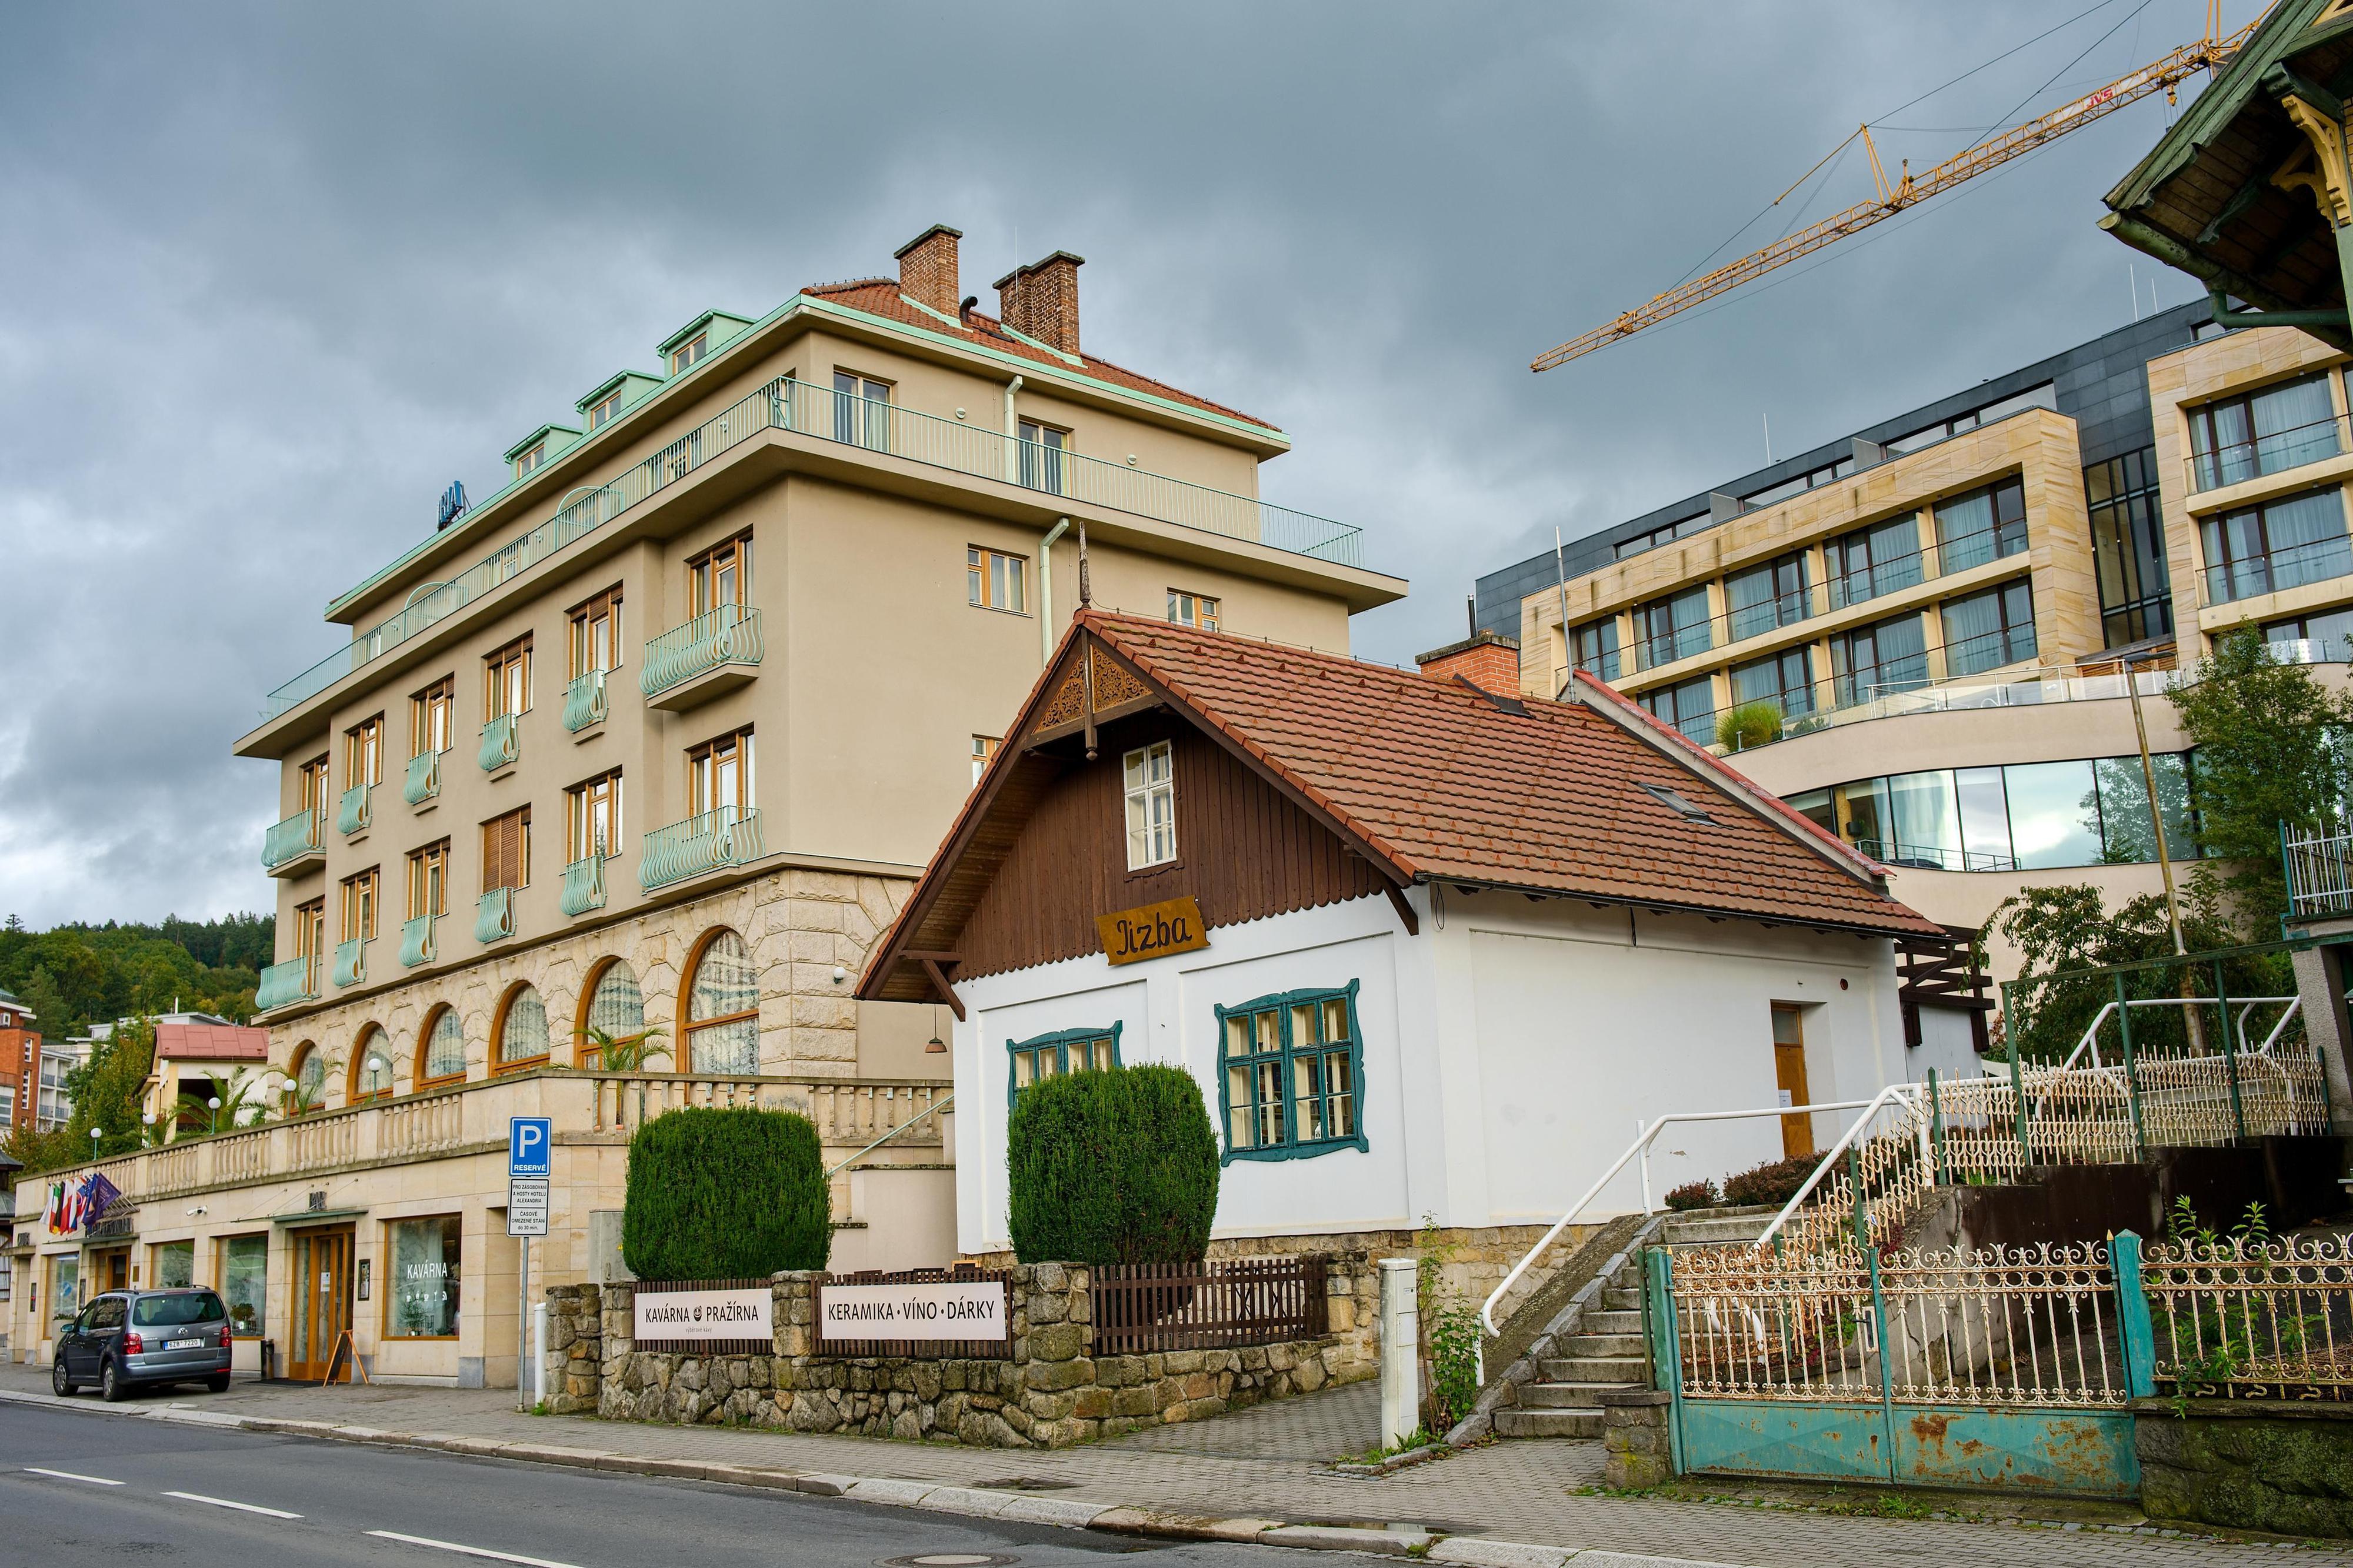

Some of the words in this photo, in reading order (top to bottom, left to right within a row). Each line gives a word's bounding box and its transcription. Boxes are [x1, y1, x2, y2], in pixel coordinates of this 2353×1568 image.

[1116, 911, 1193, 956] Jizba
[519, 1125, 542, 1157] P
[514, 1163, 546, 1172] RESERVÉ
[407, 1259, 448, 1279] KAVÁRNA
[645, 1303, 690, 1323] KAVÁRNA
[706, 1300, 759, 1322] PRAŽÍRNA
[828, 1303, 894, 1320] KERAMIKA
[902, 1297, 937, 1320] VÍNO
[947, 1296, 995, 1319] DÁRKY
